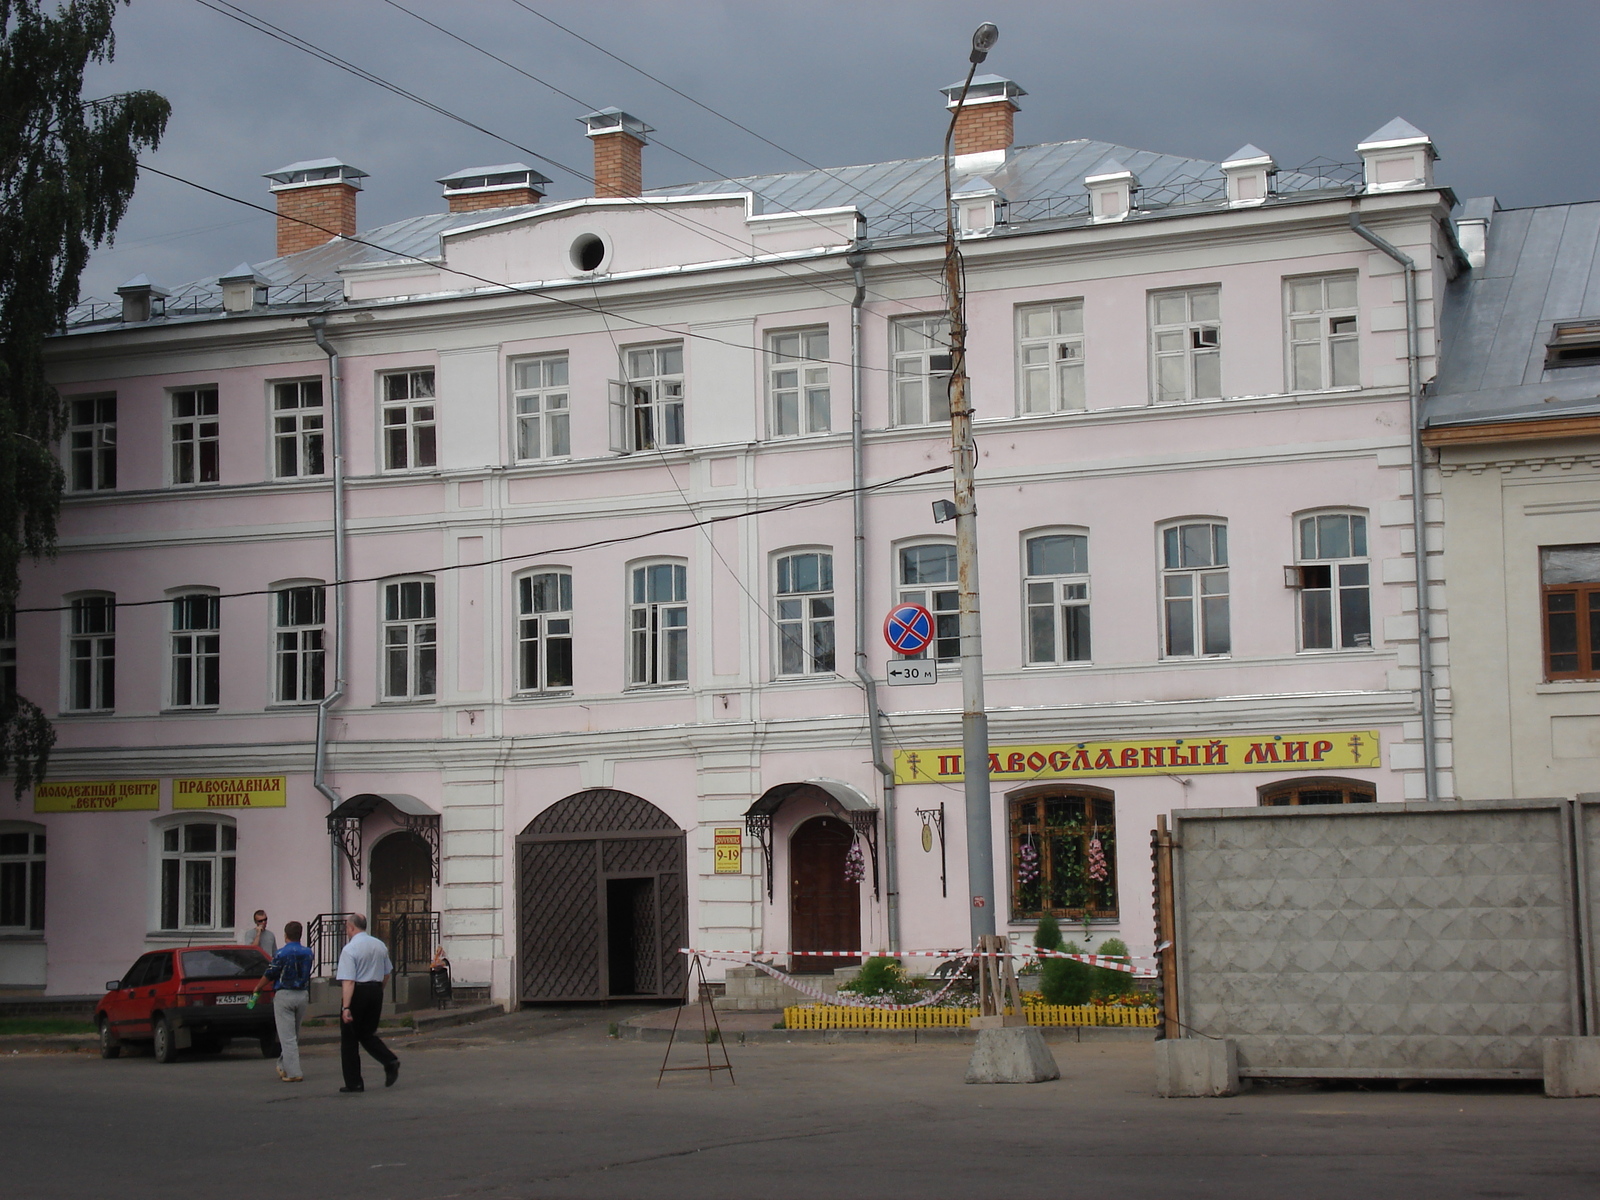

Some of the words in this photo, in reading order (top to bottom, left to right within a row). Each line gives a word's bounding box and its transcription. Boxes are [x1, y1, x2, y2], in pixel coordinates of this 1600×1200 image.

[904, 668, 919, 678] 30
[937, 740, 1228, 776] ПАВОСЛАВНЫЙ
[1244, 740, 1332, 764] МИР
[37, 783, 116, 798] МОЛОДЕЖНЫЙ
[119, 783, 158, 797] ЦЕНТР
[178, 778, 281, 794] ПРАВОСЛАВНАЯ
[207, 793, 252, 807] КНИГА
[717, 849, 739, 860] 9-19
